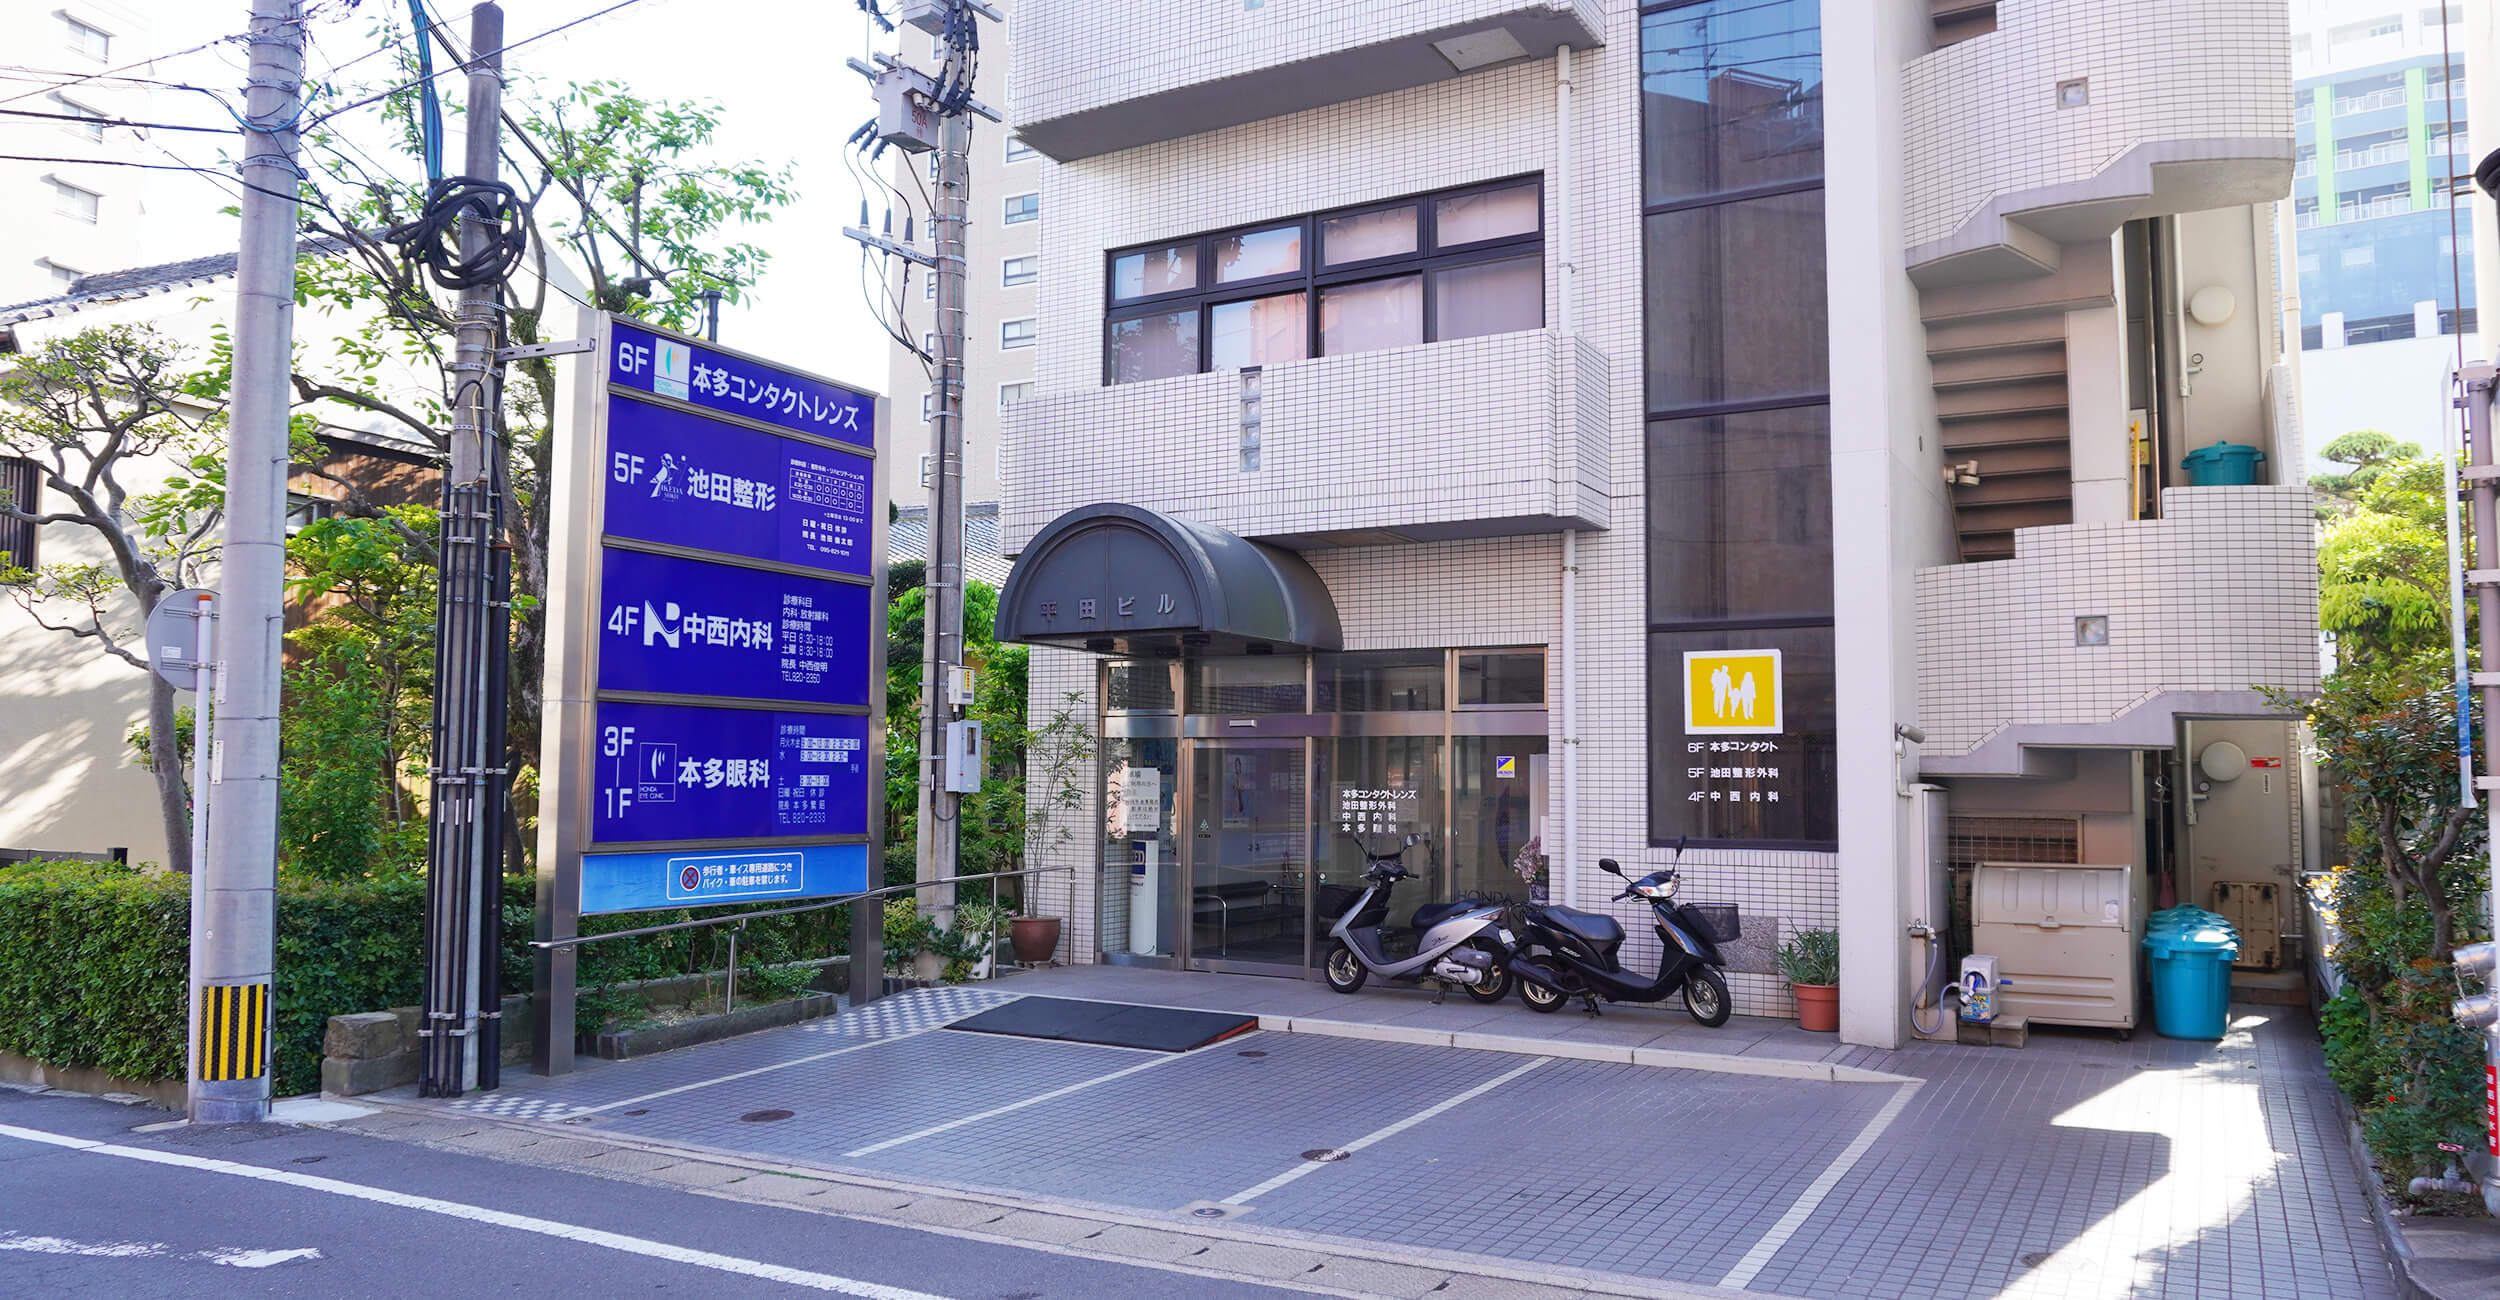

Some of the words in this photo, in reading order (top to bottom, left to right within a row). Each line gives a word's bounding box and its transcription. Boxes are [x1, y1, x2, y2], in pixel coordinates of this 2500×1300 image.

[618, 342, 649, 375] 6F
[692, 363, 859, 432] 本多コンタクトレンズ
[614, 452, 645, 485] 5F
[687, 467, 777, 512] 池田整形
[783, 594, 812, 608] 診療科目
[1040, 593, 1175, 623] 平田ビル
[608, 605, 640, 636] 4F
[782, 619, 811, 632] 診療時間
[683, 612, 773, 651] 中西内科
[781, 631, 797, 643] 平日
[781, 644, 797, 655] 土曜
[781, 658, 797, 670] 院長
[780, 725, 806, 736] 診療時間
[604, 726, 635, 757] 3F
[1687, 743, 1705, 753] 6F
[1710, 741, 1778, 752] 本多コンタクト
[678, 757, 770, 789] 本多眼科
[1687, 768, 1705, 779] 5F
[1710, 767, 1779, 779] 池田整形外科
[1342, 789, 1417, 799] 本多コンタクトレンズ
[1687, 792, 1705, 802] 4F
[1710, 791, 1779, 803] 中西内科
[605, 788, 633, 819] 1F
[1342, 800, 1397, 811] 池田整形外科
[778, 812, 791, 824] TEL
[1342, 812, 1397, 823] 中西内科
[1342, 823, 1397, 834] 本多眼科
